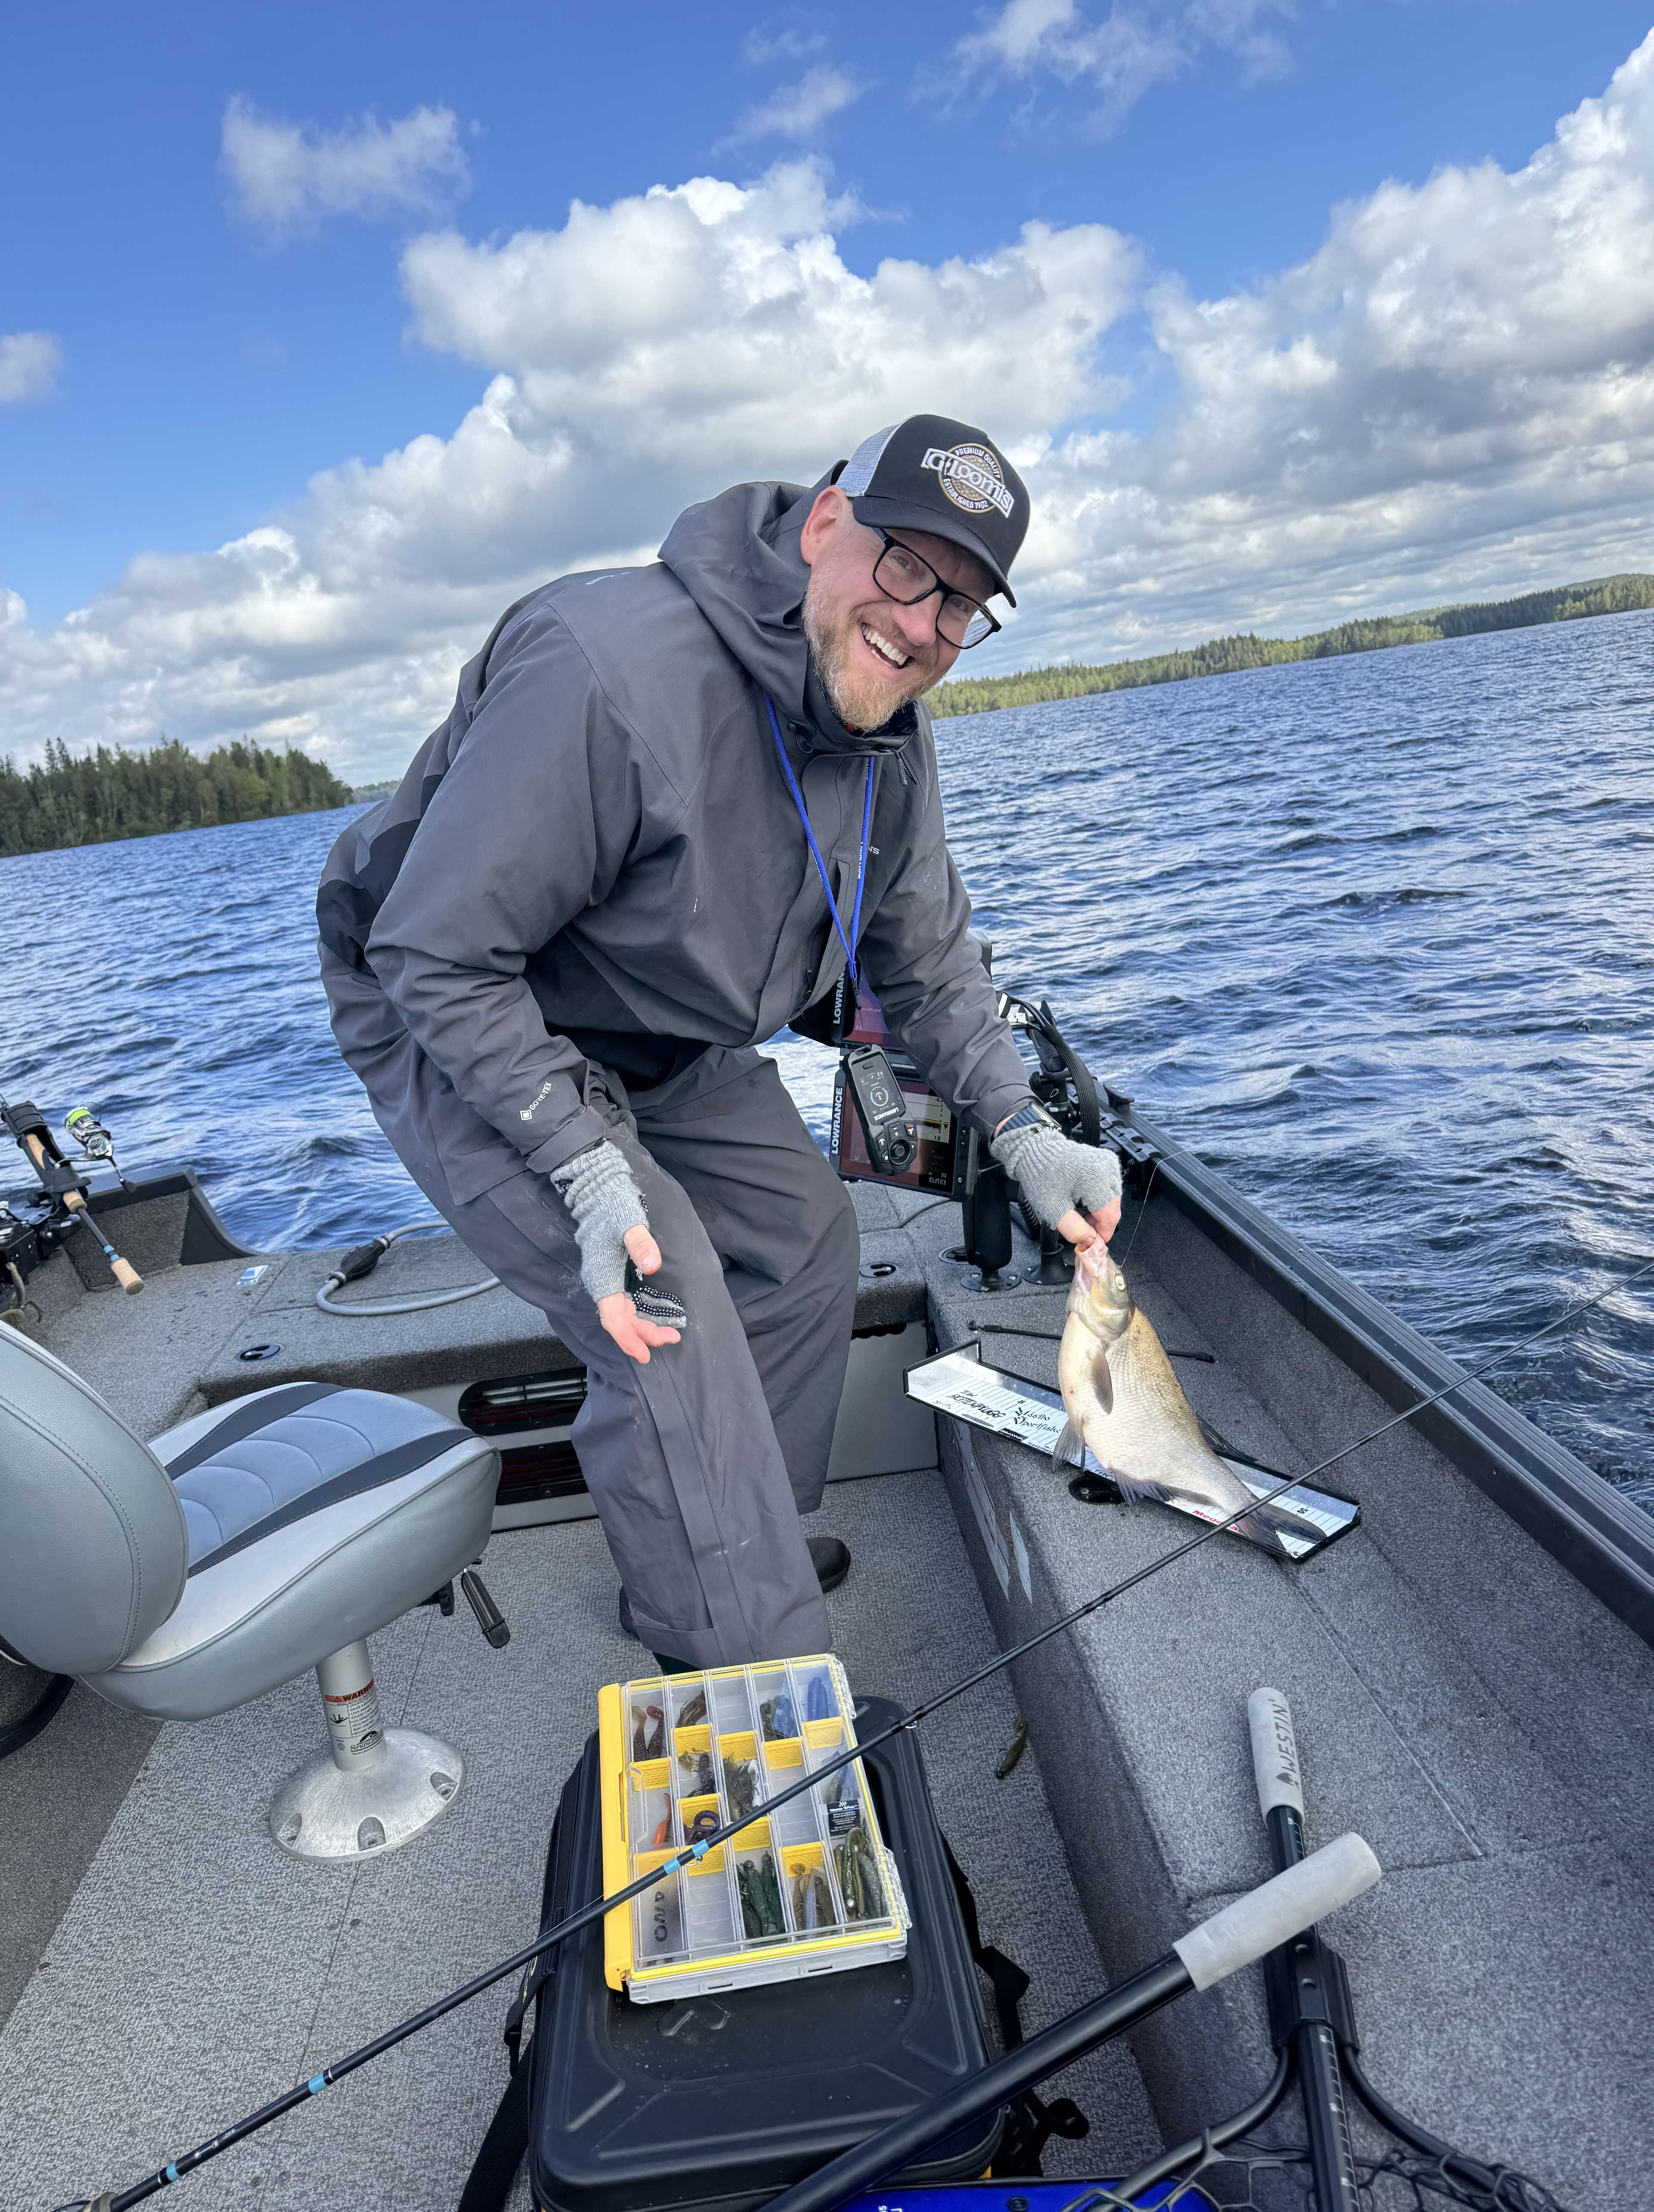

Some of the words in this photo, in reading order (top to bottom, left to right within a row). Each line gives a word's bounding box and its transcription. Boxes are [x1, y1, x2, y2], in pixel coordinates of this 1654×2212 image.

[955, 447, 985, 456] PREMIUM
[983, 454, 1001, 479] QUALITY
[942, 478, 974, 509] ESTABLISHED
[833, 966, 846, 1025] LOWRAN
[529, 1081, 552, 1110] GORE-TEX
[831, 1087, 843, 1155] LOWRANCE
[874, 1107, 899, 1121] LOWRANCE
[343, 1679, 373, 1701] WARNIN
[1272, 1703, 1297, 1775] WESTIN
